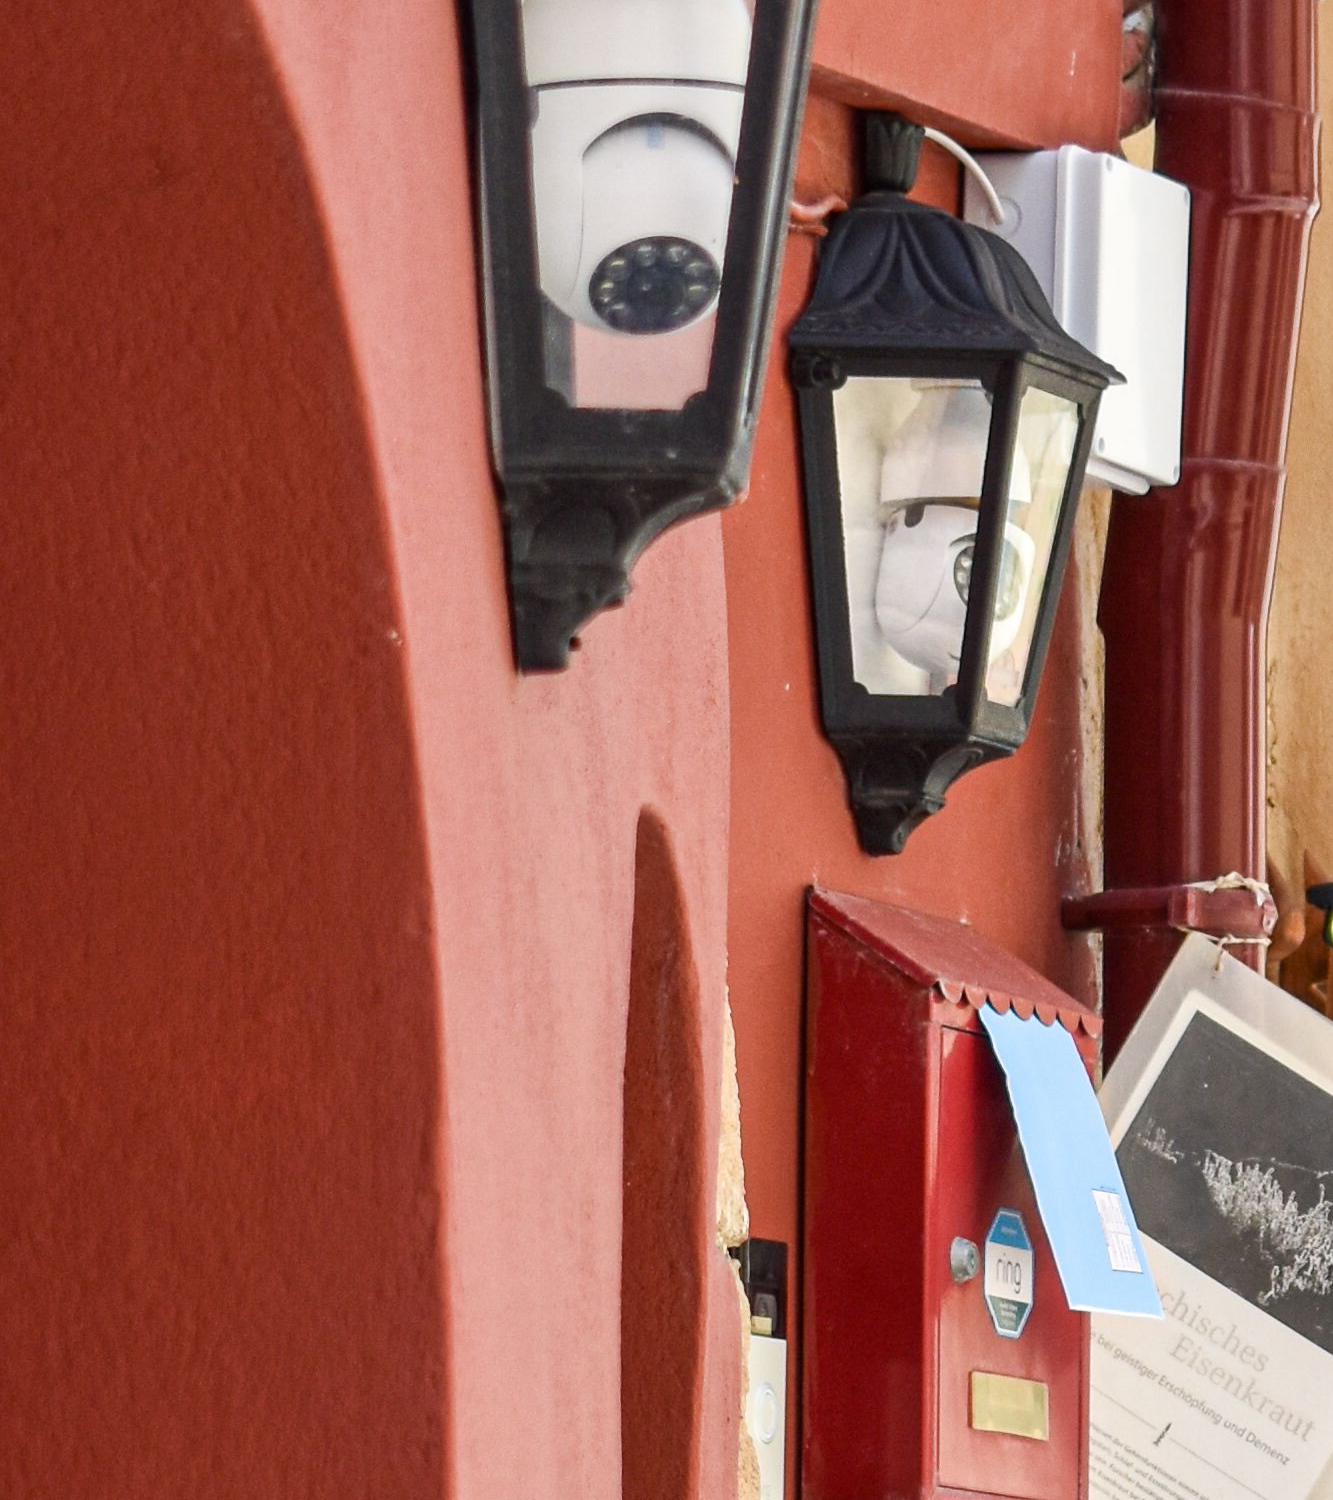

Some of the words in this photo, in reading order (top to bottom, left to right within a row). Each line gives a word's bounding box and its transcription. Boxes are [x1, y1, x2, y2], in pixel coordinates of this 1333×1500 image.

[995, 1252, 1022, 1294] ring
[1153, 1283, 1275, 1375] chisches
[1094, 1333, 1116, 1352] bei
[1111, 1345, 1160, 1383] geistiger
[1155, 1373, 1226, 1425] Erschöpfung
[1221, 1415, 1247, 1438] und
[1244, 1430, 1291, 1466] Demenz
[1166, 1332, 1320, 1443] Eisenkraut
